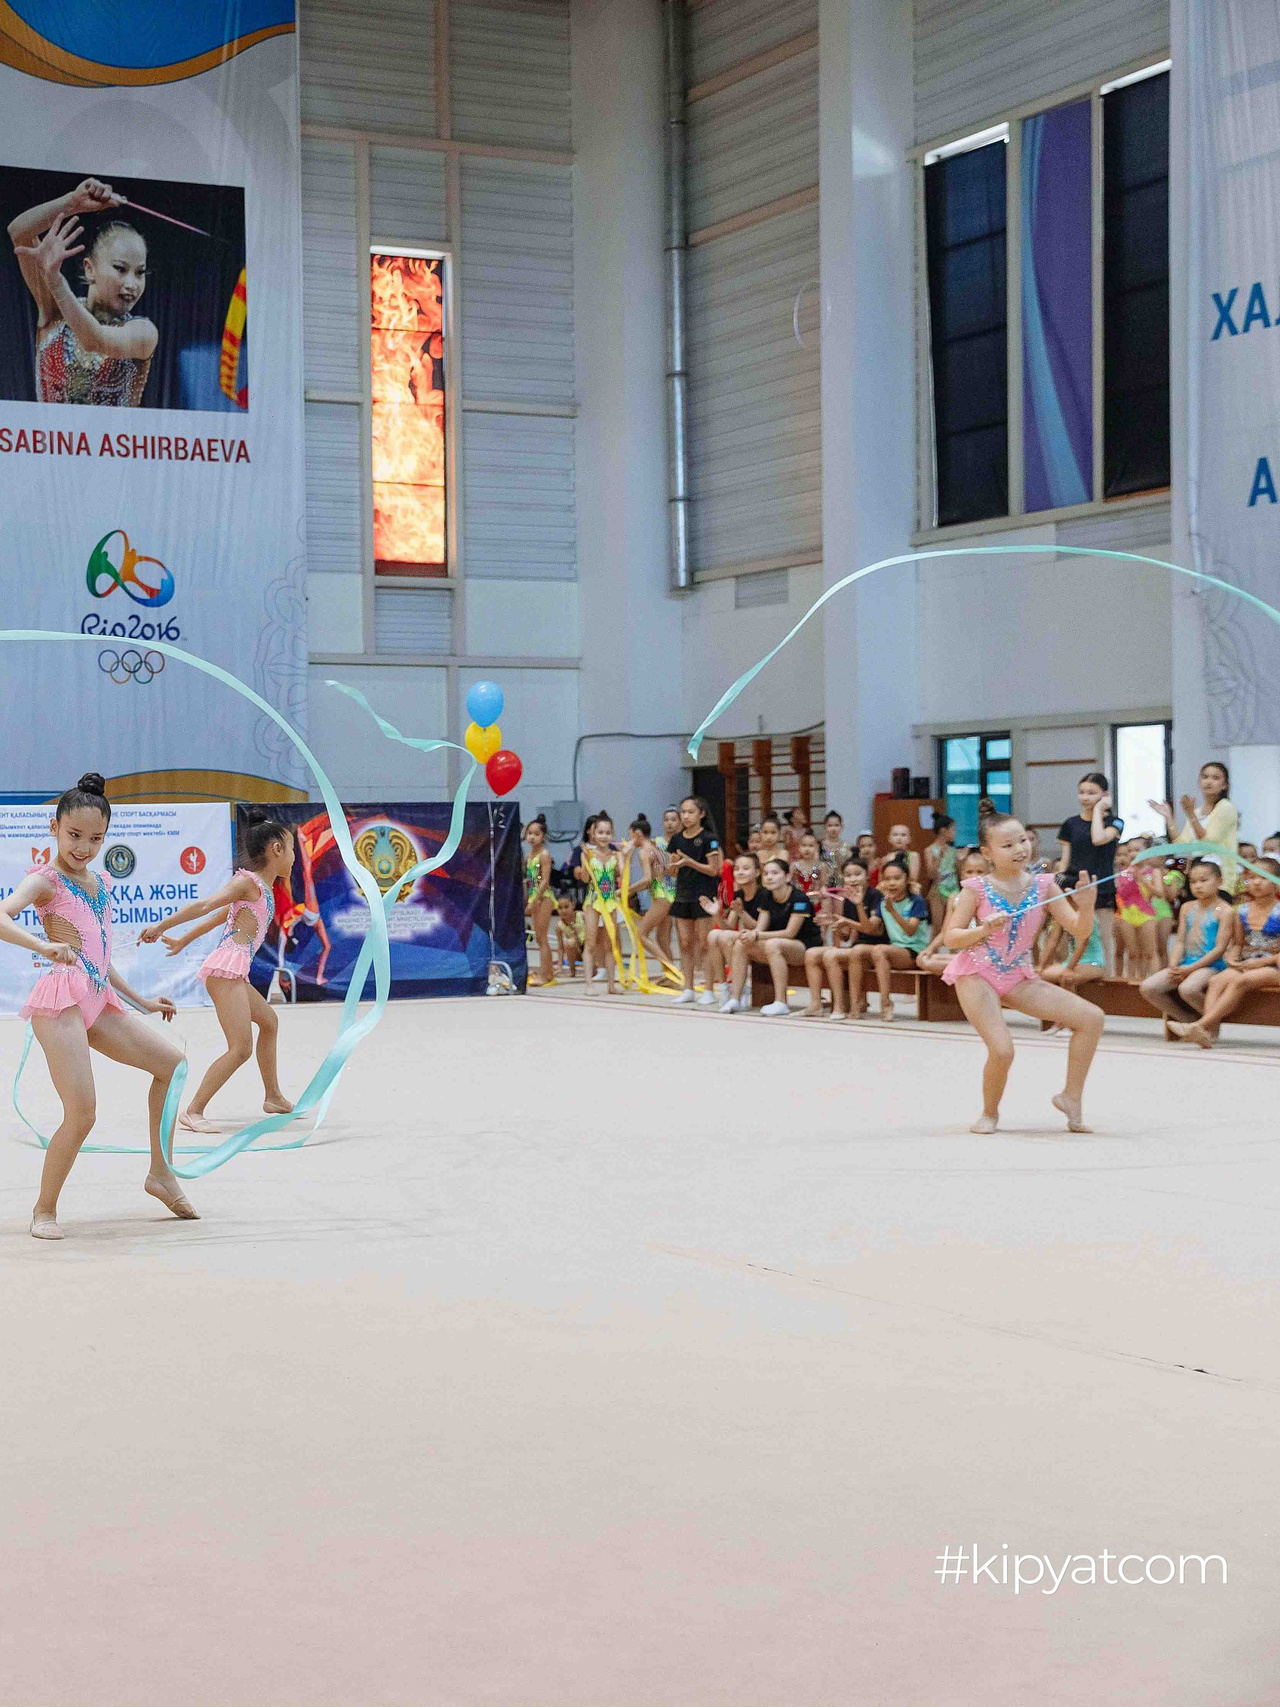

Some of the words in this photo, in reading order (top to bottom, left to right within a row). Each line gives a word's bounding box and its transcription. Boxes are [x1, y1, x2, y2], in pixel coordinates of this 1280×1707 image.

[1210, 282, 1280, 341] ХА
[98, 434, 251, 463] ASHIRBAEVA
[149, 884, 199, 900] ЖӘНЕ
